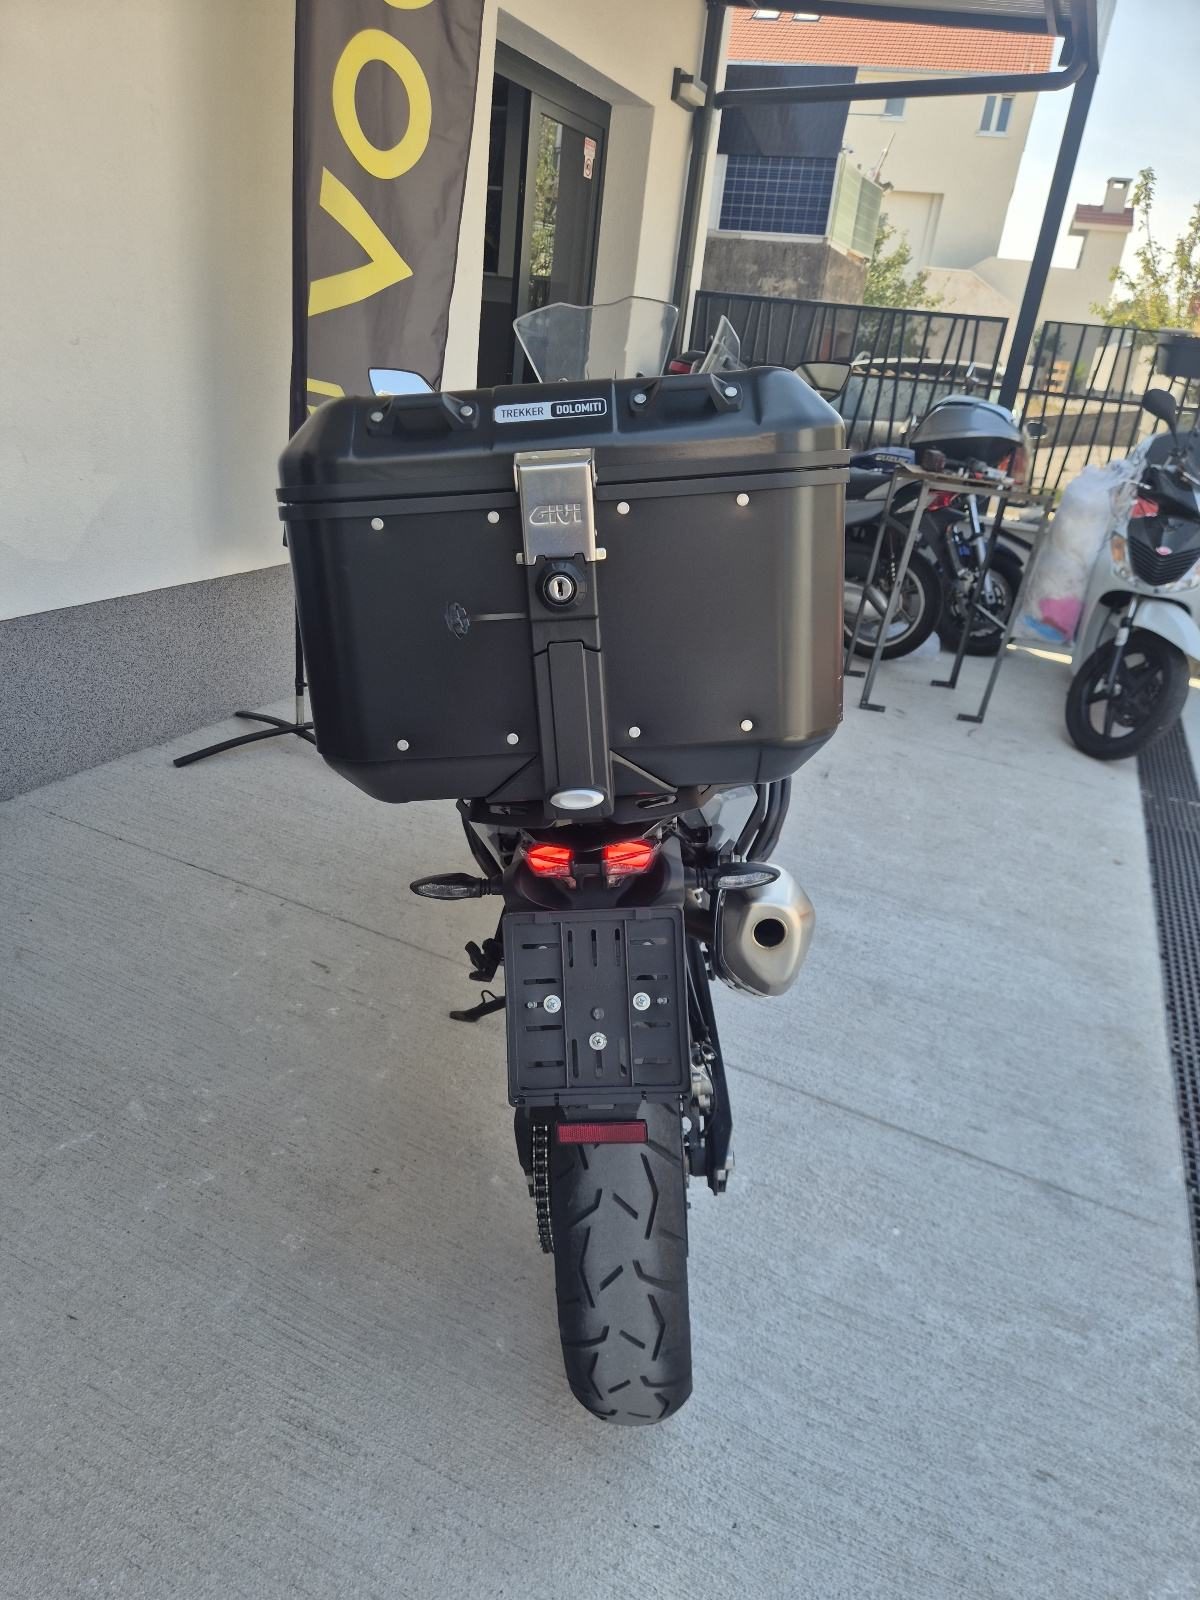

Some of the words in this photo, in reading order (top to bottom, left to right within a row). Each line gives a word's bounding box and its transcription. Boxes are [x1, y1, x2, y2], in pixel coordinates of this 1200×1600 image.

[308, 0, 434, 316] VO
[502, 406, 544, 419] TREKKER
[556, 402, 602, 415] DOLOMITI
[529, 503, 582, 525] GIVI
